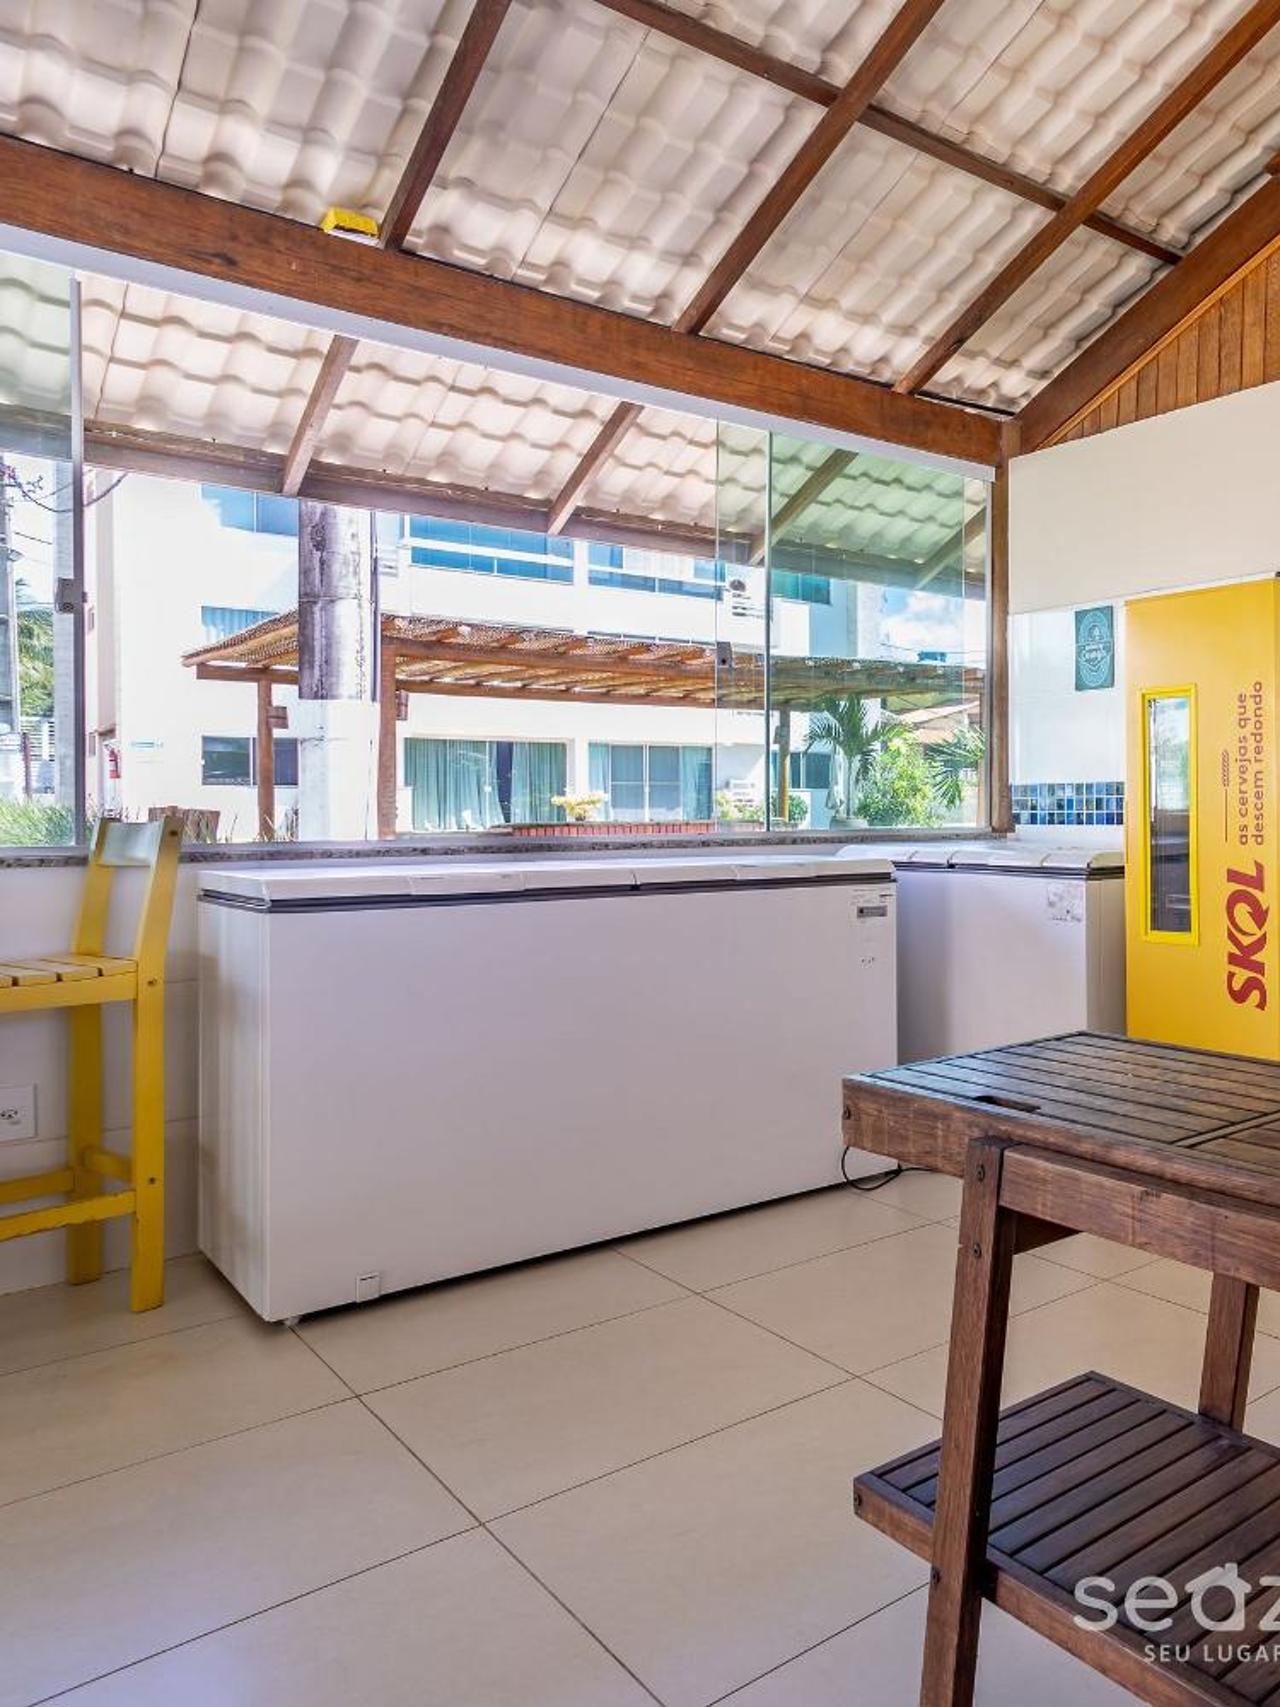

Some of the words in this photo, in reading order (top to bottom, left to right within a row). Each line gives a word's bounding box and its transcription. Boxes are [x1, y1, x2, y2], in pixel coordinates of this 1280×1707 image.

[1238, 692, 1251, 730] que
[1250, 681, 1264, 764] redondo
[1235, 734, 1252, 818] cervejas
[1251, 770, 1264, 846] descem
[1238, 825, 1249, 846] as
[1226, 859, 1270, 1011] SKOL
